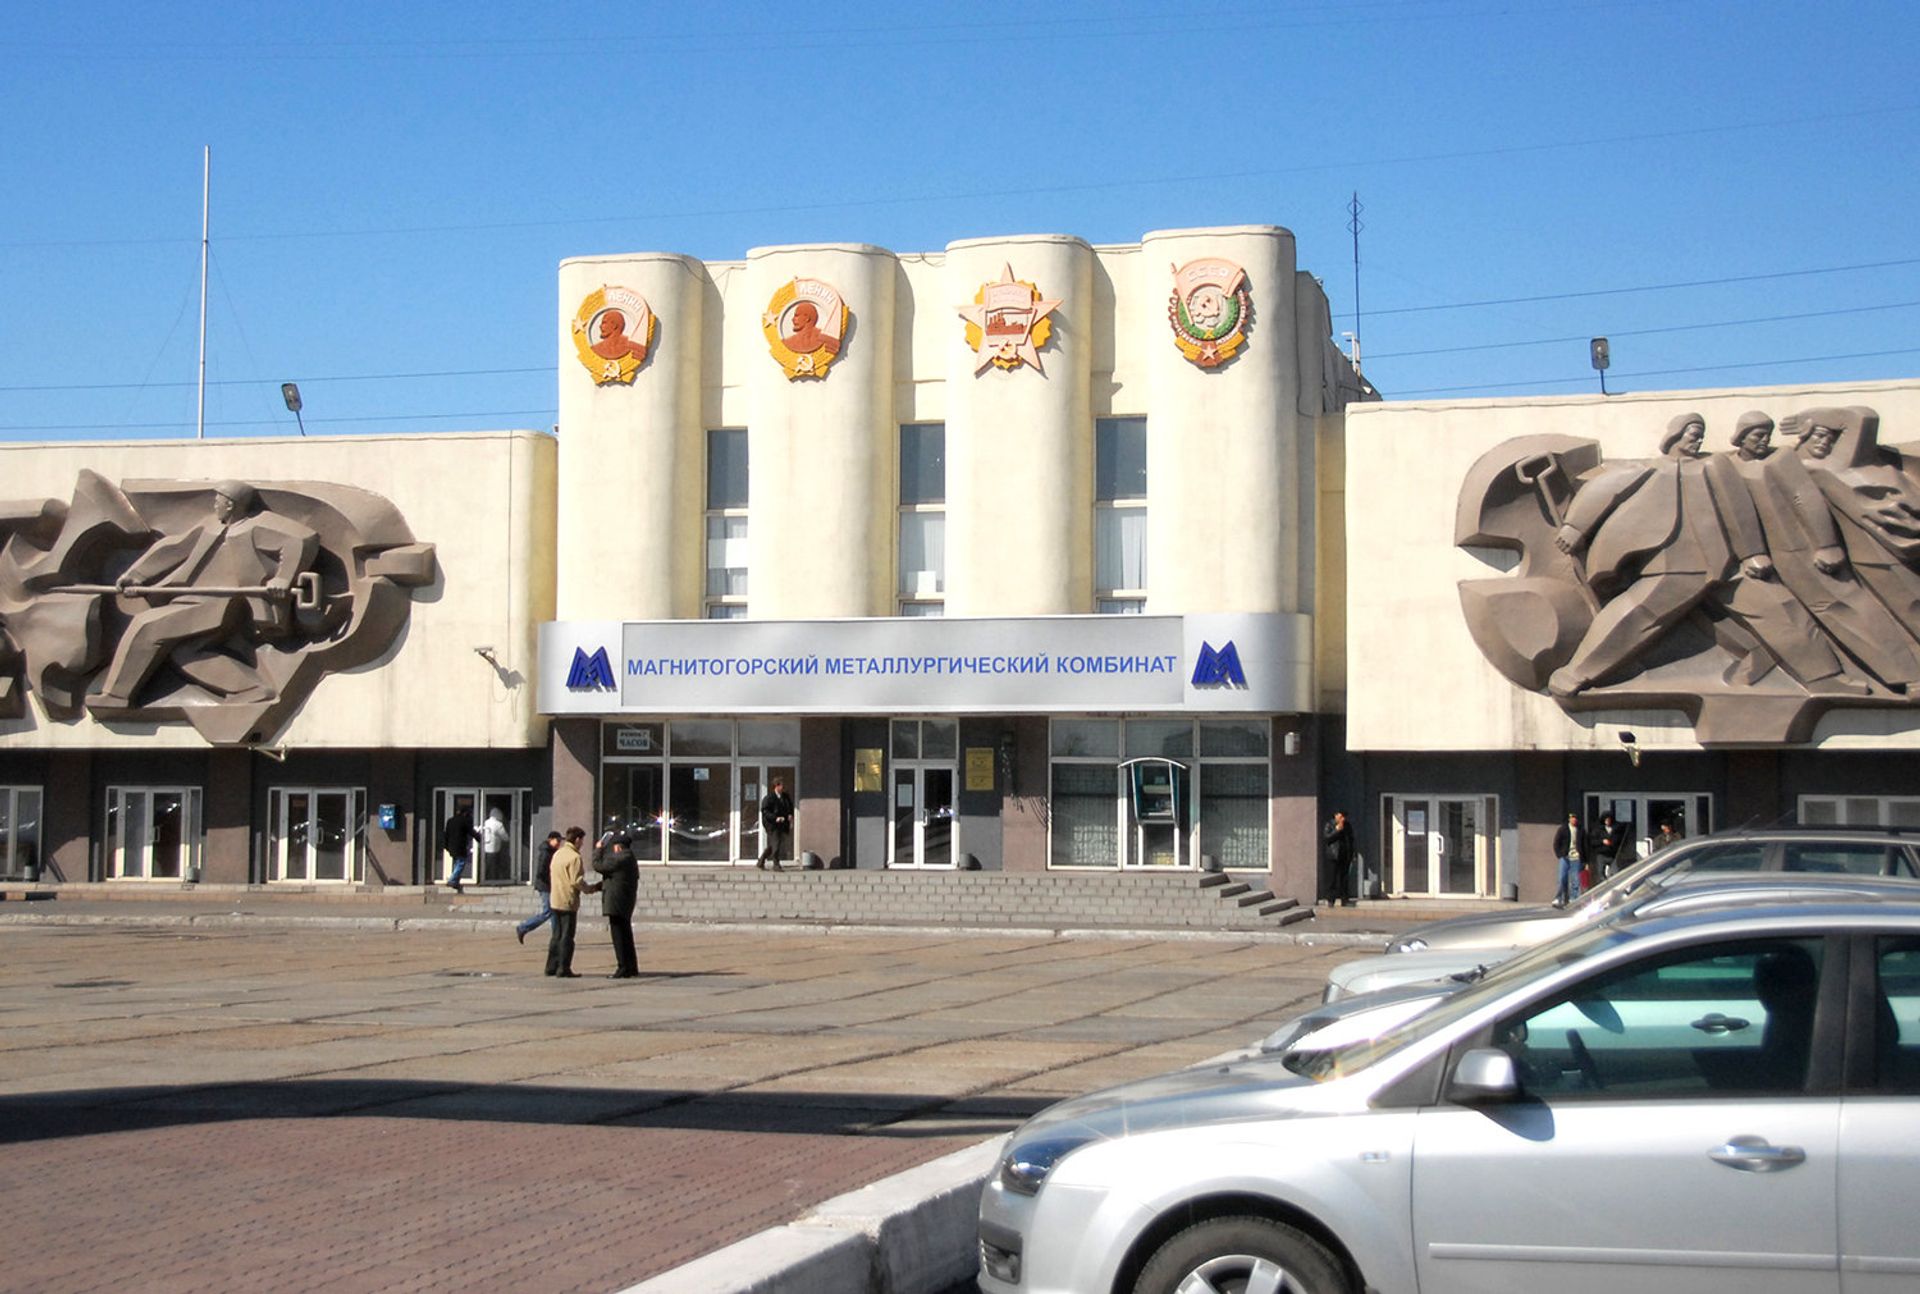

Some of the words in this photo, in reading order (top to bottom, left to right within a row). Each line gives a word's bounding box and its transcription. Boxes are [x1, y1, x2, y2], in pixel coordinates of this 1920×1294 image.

[607, 291, 643, 313] ЛЕНИН
[799, 282, 837, 305] ЛЕНИН
[627, 655, 819, 676] МАГНИТОГОРСКИЙ
[825, 652, 1049, 676] МЕТАЛЛУРГИЧЕСКИЙ
[1056, 655, 1177, 674] КОМБИНАТ
[619, 738, 648, 747] ЧАСОВ
